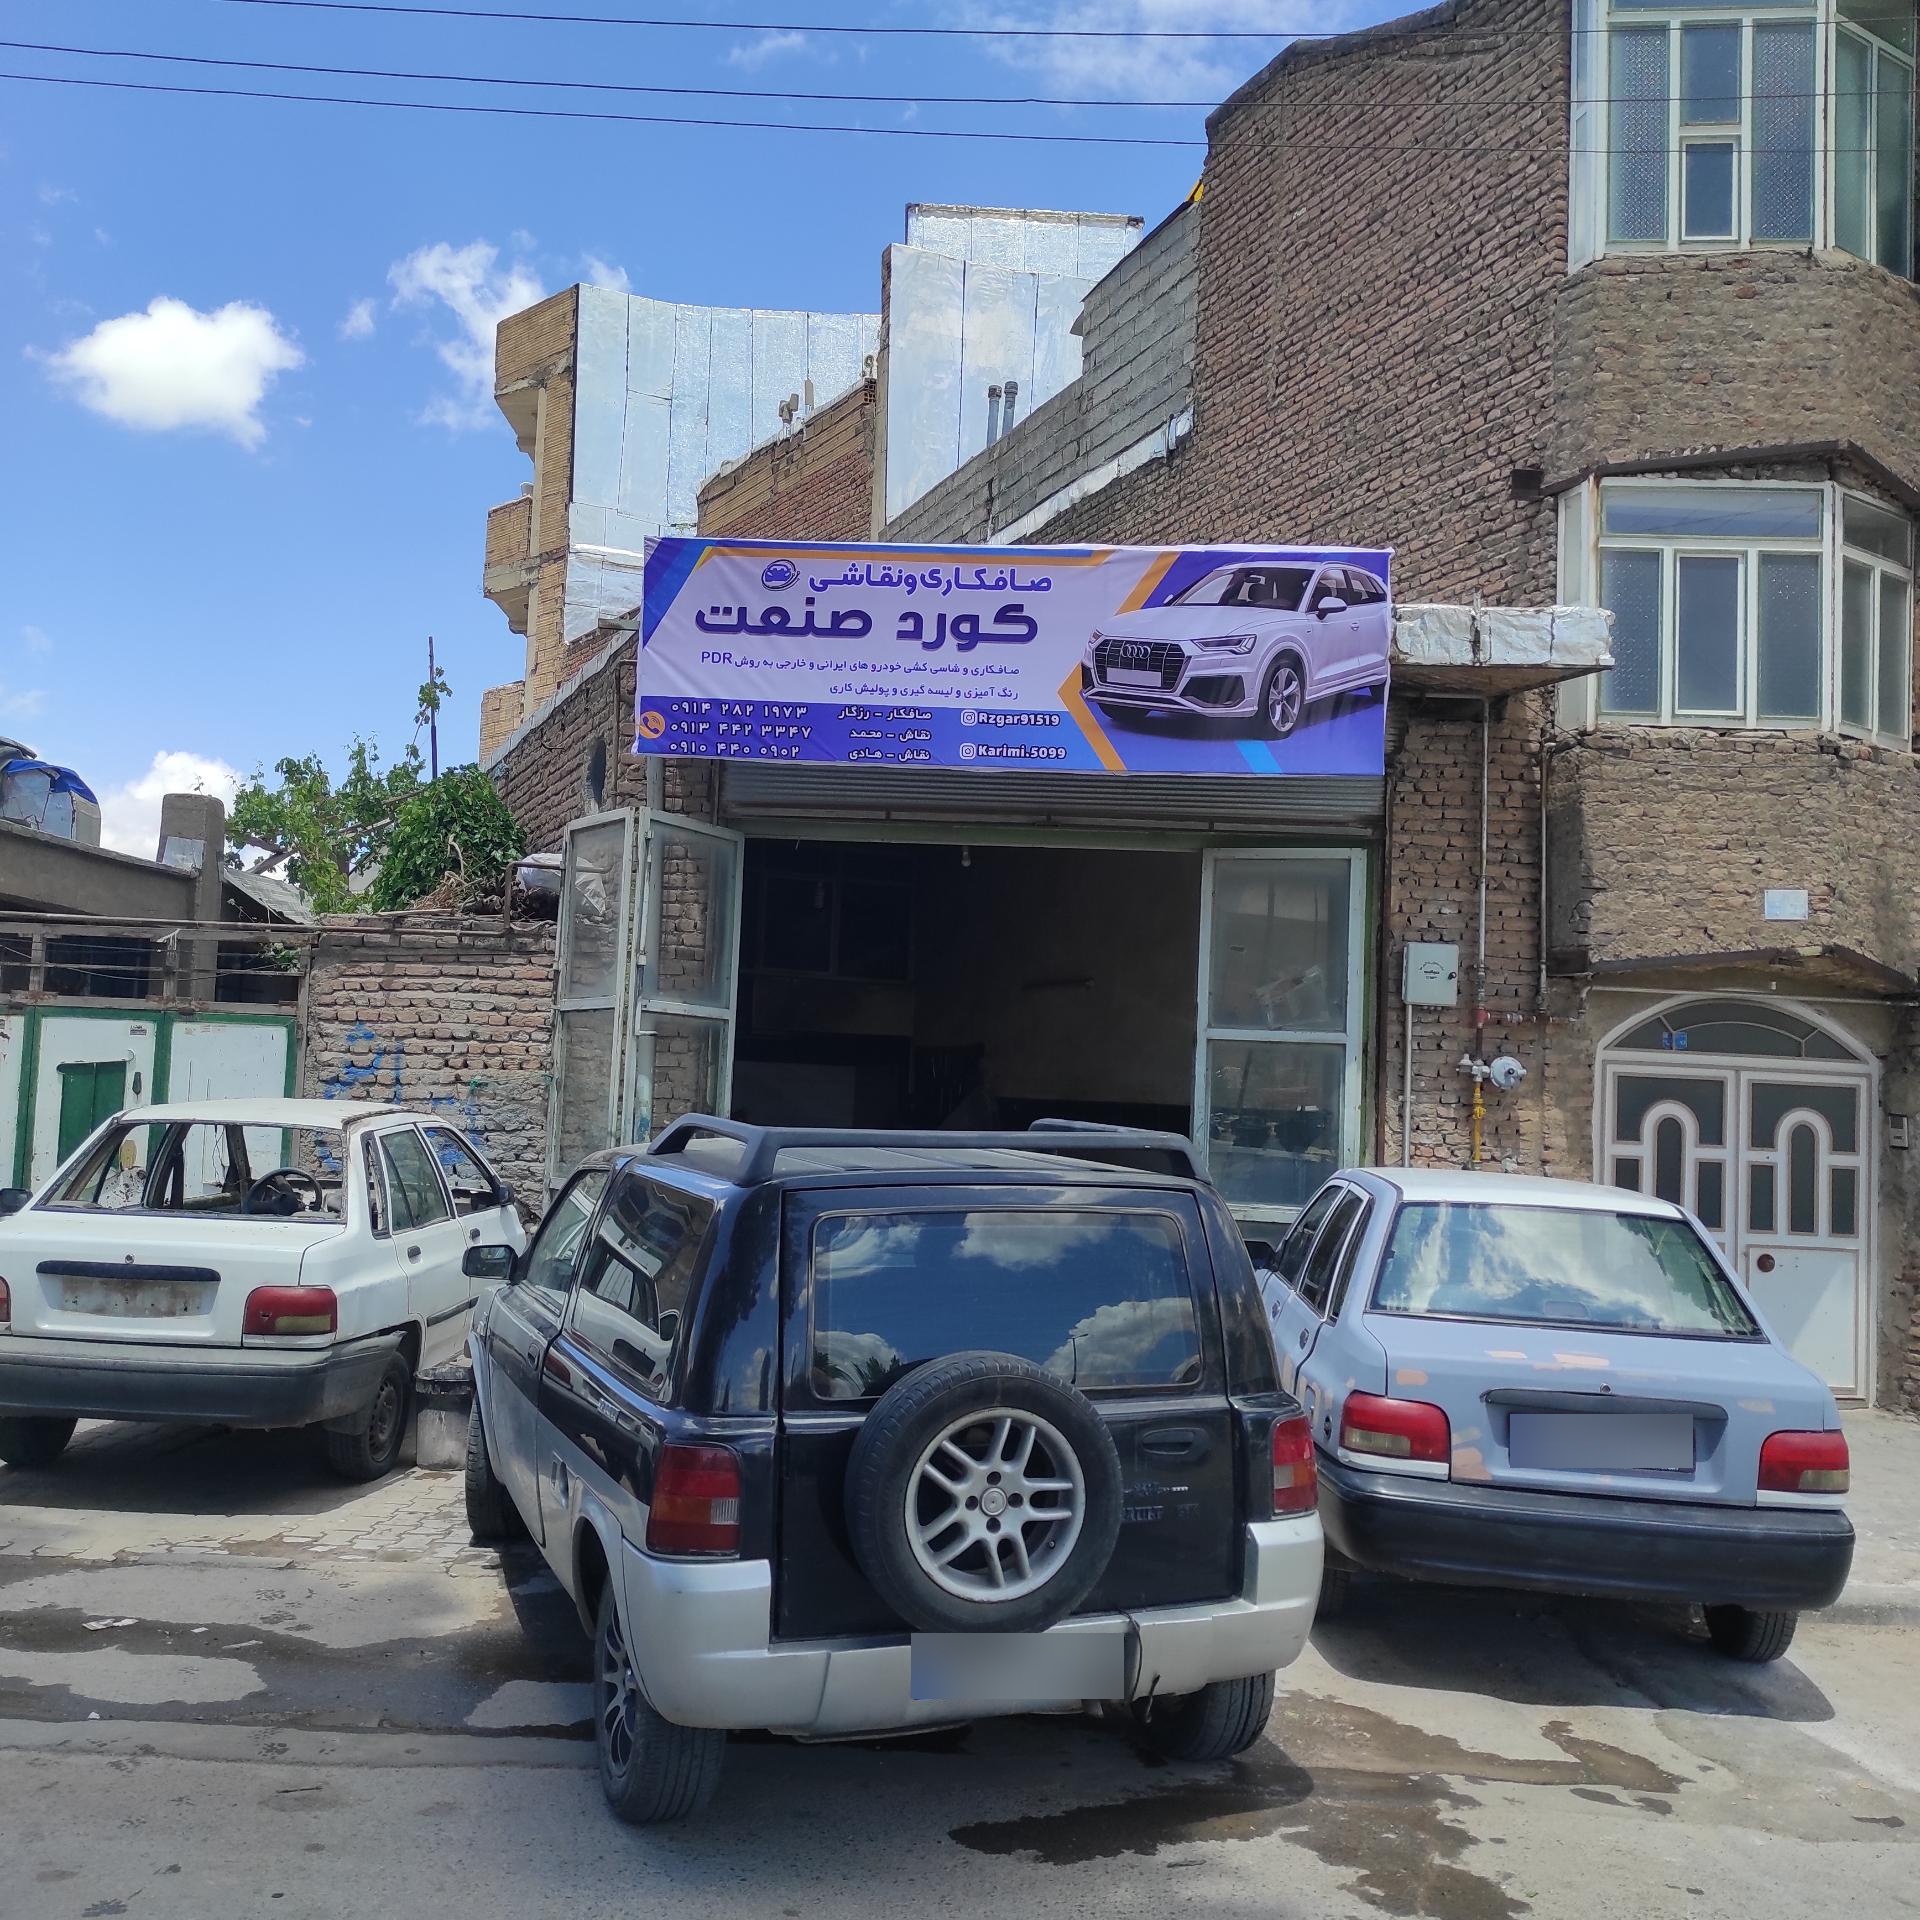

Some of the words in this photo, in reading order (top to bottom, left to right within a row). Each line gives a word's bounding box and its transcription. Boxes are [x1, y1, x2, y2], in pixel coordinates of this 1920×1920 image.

[919, 566, 1053, 597] صافکاری
[695, 597, 873, 639] صنعت
[896, 603, 1038, 653] کورد
[700, 651, 733, 664] PDR
[734, 655, 760, 669] روش
[762, 659, 774, 669] به
[775, 657, 807, 670] خارجی
[808, 661, 816, 670] و
[816, 659, 847, 672] ایرانی
[903, 661, 928, 674] کشی
[929, 662, 961, 675] شاسی
[962, 667, 969, 675] و
[970, 663, 1020, 677] صافکاری
[829, 682, 853, 695] کاری
[854, 682, 890, 698] پولیش
[899, 684, 926, 697] گیری
[927, 686, 954, 698] لیسه
[963, 685, 996, 699] آمیزی
[997, 686, 1019, 700] رنگ
[671, 701, 712, 714] ۰۹۱۴
[721, 703, 754, 716] ۲۸۲
[763, 705, 808, 718] ۱۹۷۳
[837, 705, 870, 720] رزگار
[887, 707, 932, 721] صافکار
[978, 712, 1061, 727] Rzgar91519
[670, 721, 710, 734] ۰۹۱۳
[719, 723, 752, 736] ۴۴۲
[761, 725, 812, 738] ۳۳۴۷
[850, 729, 882, 739] محمد
[899, 728, 931, 742] نقاش
[848, 748, 882, 760] هادی
[898, 748, 931, 762] نقاش
[977, 744, 1067, 760] Karimi.5099
